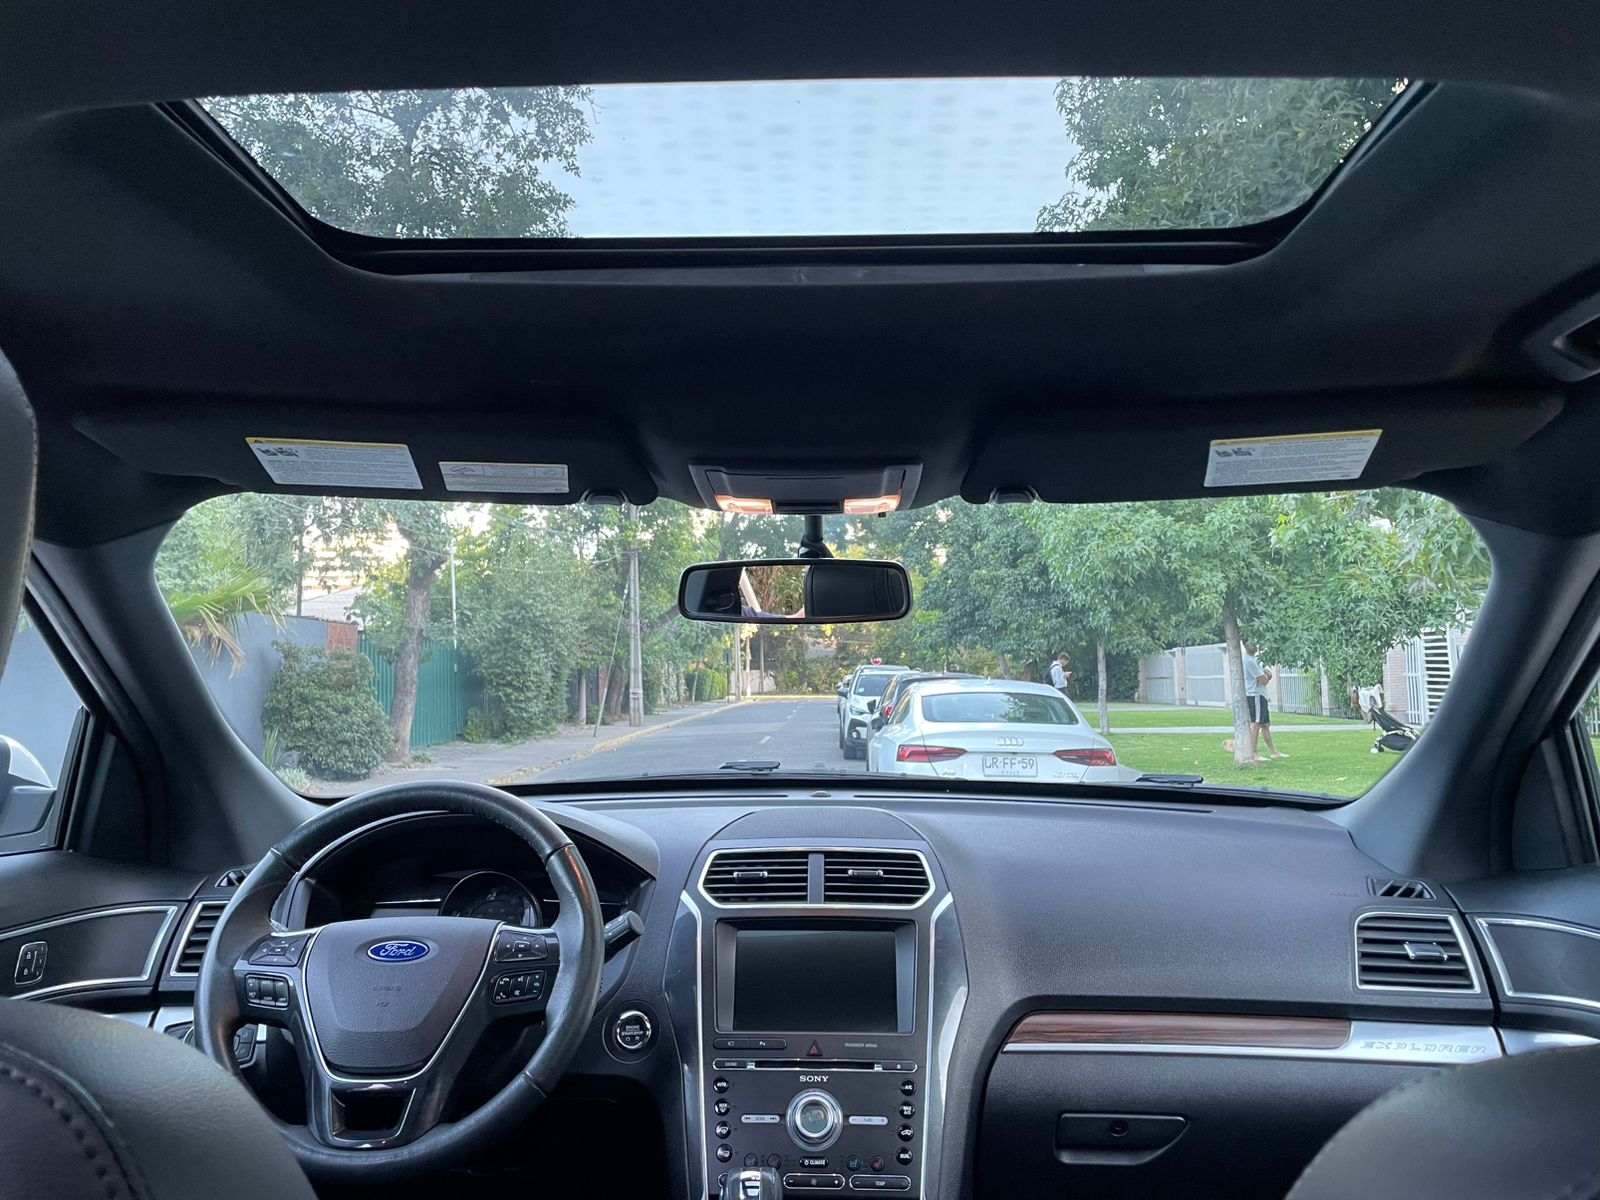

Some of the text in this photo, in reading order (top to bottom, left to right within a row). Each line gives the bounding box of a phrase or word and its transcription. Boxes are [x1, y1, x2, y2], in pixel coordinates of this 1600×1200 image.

[379, 943, 417, 957] Ford
[1360, 1040, 1487, 1054] EXPLORER
[799, 1075, 829, 1083] SONY
